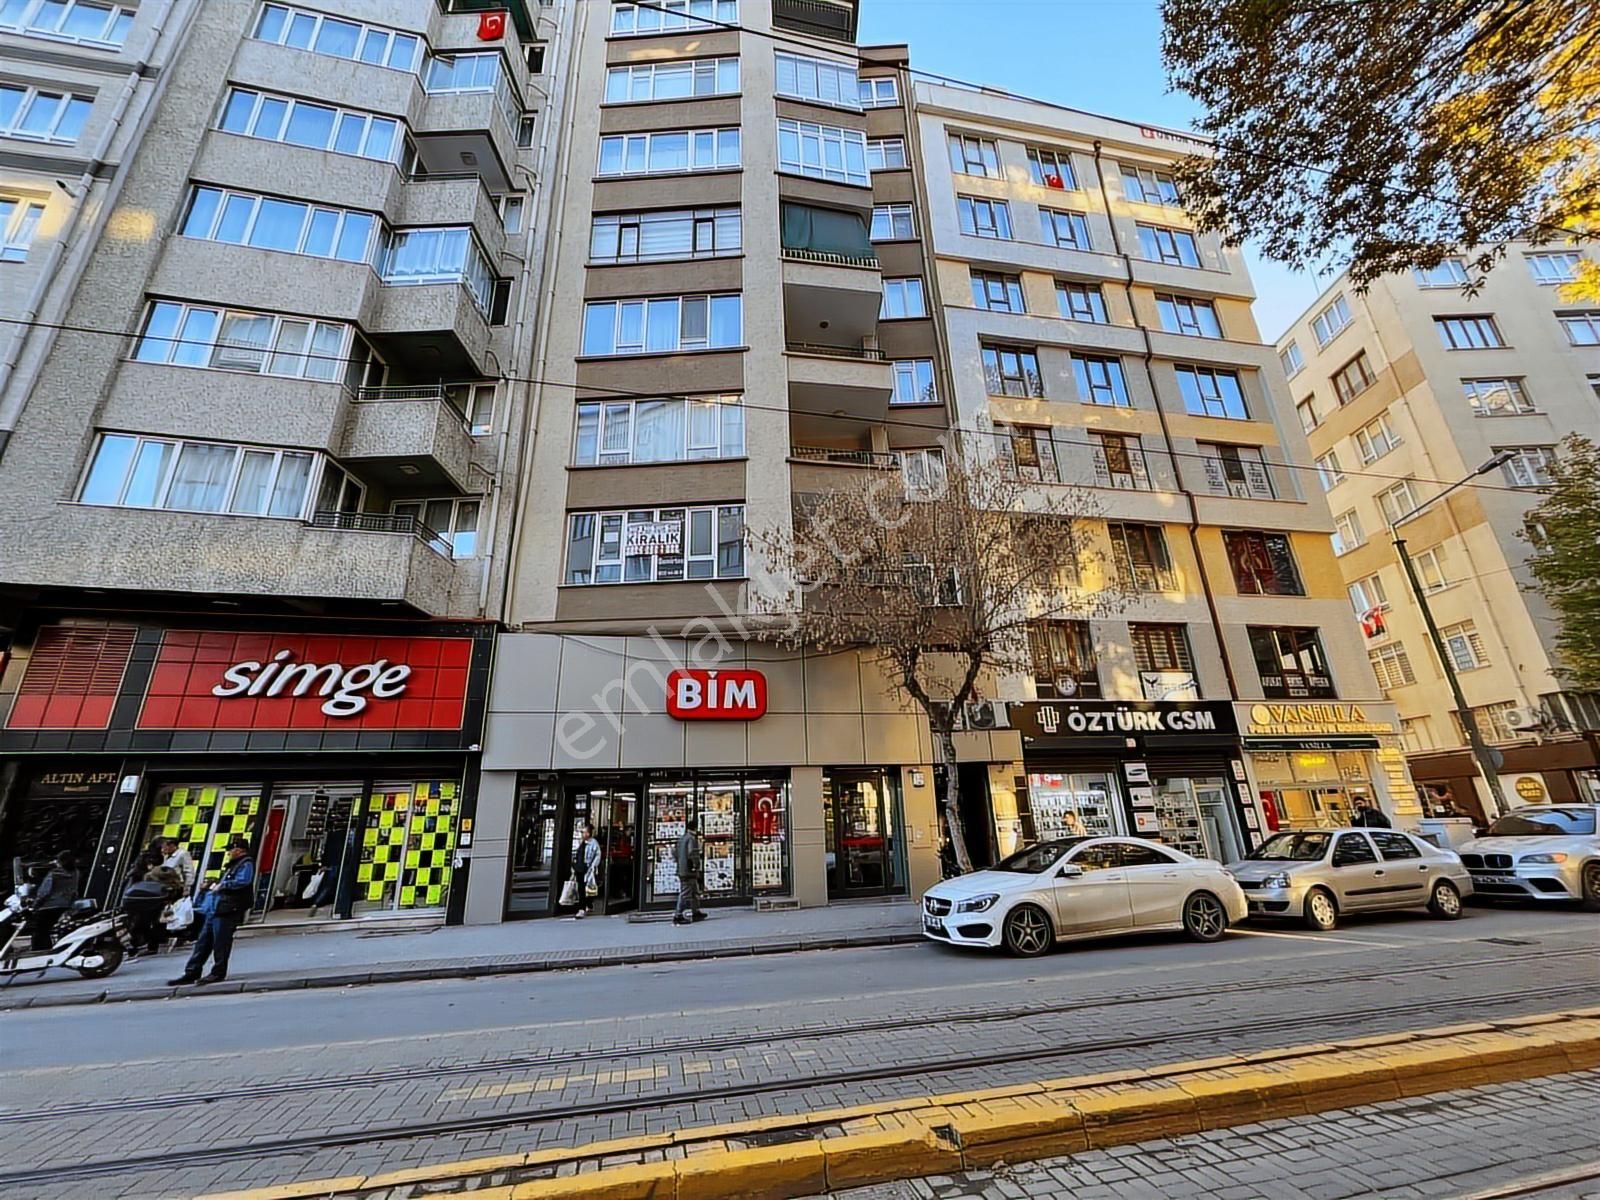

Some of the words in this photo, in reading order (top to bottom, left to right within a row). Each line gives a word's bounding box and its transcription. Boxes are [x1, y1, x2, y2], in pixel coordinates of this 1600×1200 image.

[211, 649, 412, 717] simge
[676, 670, 757, 710] BİM
[1067, 705, 1166, 732] ÖZTÜRK
[1166, 710, 1216, 731] GSM
[41, 772, 84, 784] ALTIN
[86, 772, 117, 784] APT.
